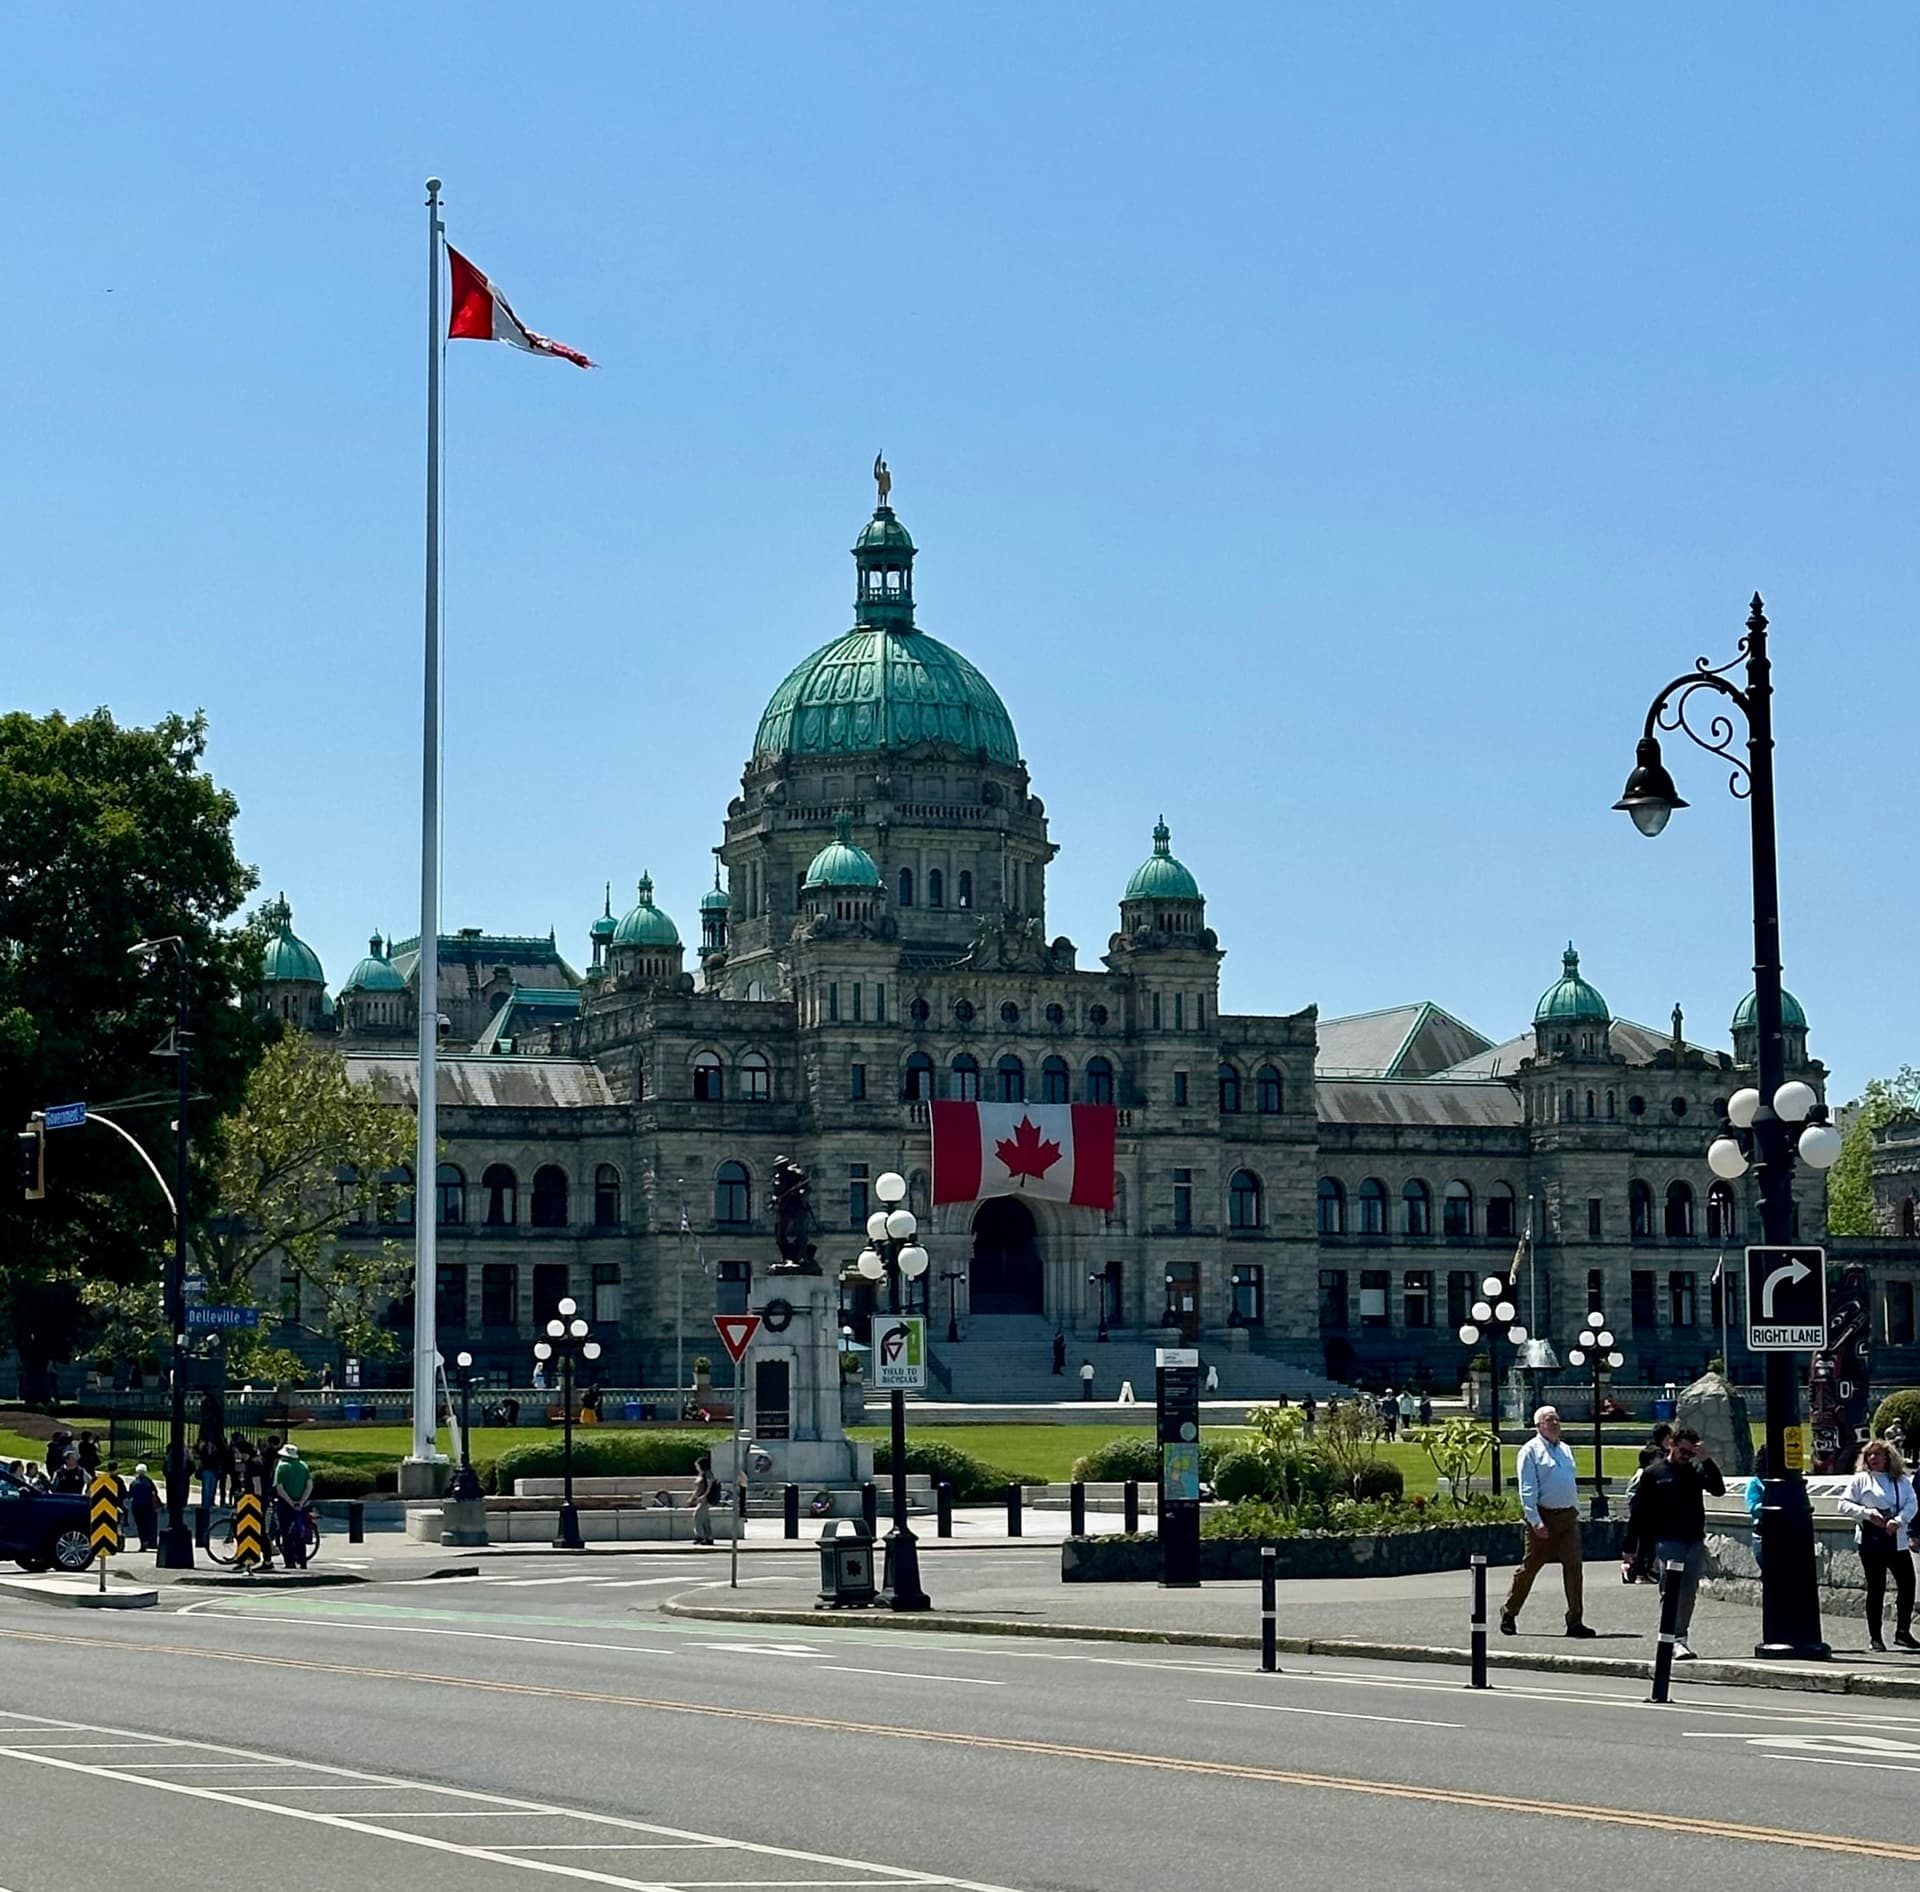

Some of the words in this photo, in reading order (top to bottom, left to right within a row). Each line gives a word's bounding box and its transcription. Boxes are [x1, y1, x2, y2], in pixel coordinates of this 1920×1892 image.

[1753, 1329, 1789, 1343] RIGHT
[1790, 1329, 1821, 1343] LANE
[882, 1367, 904, 1375] YIELD
[907, 1367, 917, 1375] TO
[882, 1376, 918, 1384] BICYCLES
